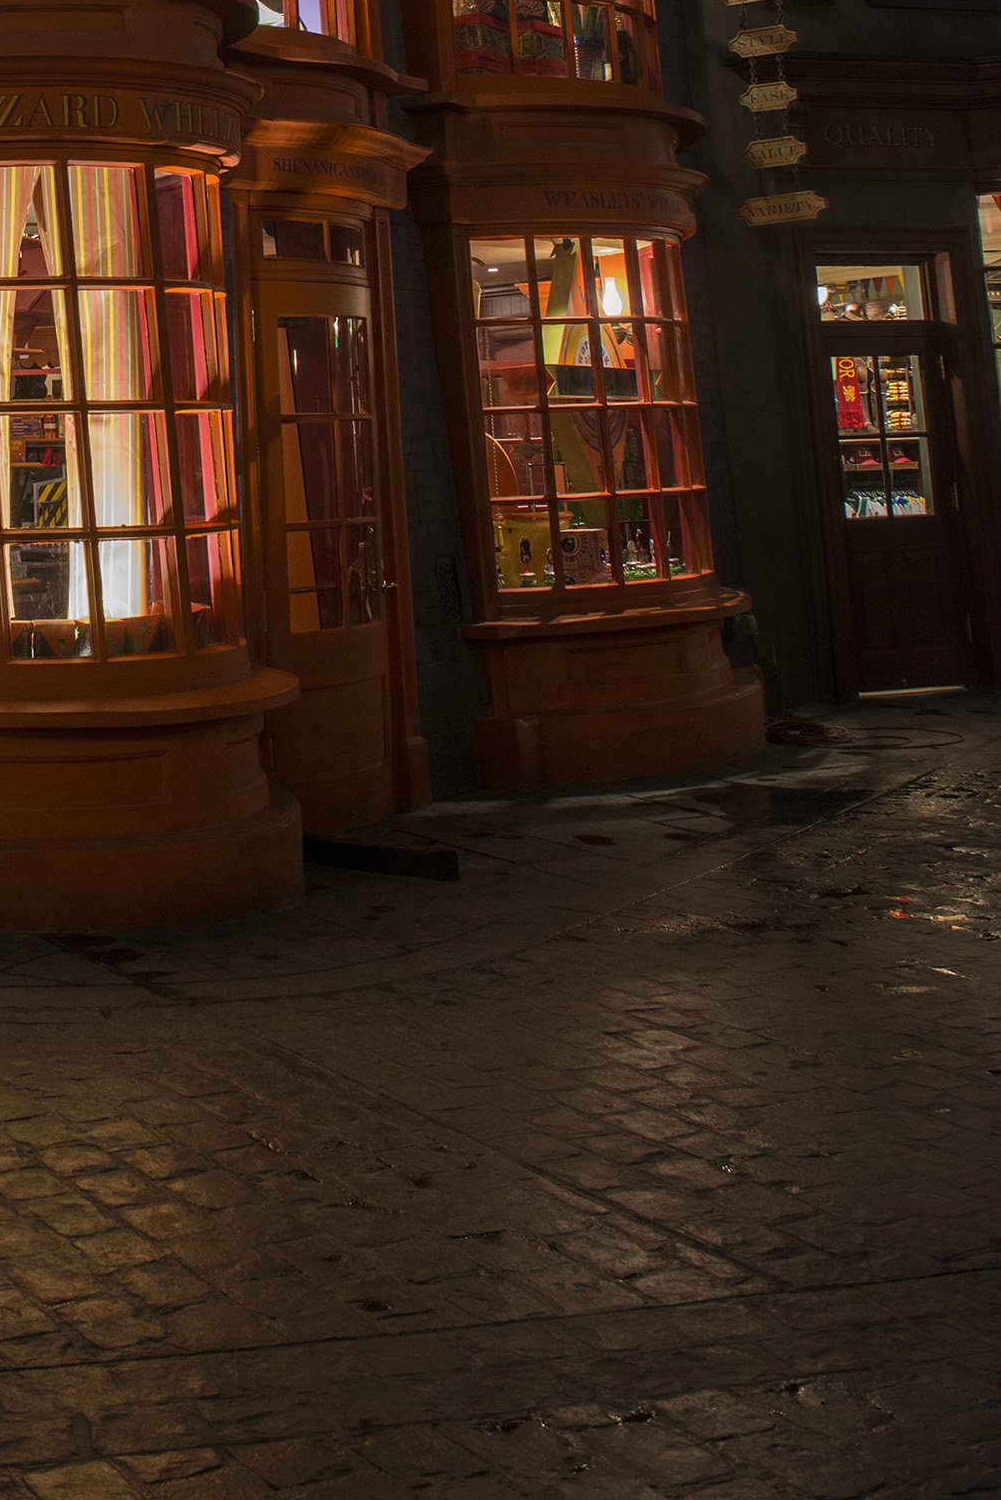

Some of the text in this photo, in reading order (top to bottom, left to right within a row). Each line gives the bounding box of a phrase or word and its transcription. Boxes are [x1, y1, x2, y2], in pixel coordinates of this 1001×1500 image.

[737, 32, 787, 48] STYLE
[750, 90, 789, 104] EASE
[825, 124, 938, 148] QUALITY
[749, 145, 798, 160] VALUE
[749, 200, 813, 217] VARIETY
[838, 356, 856, 379] OR
